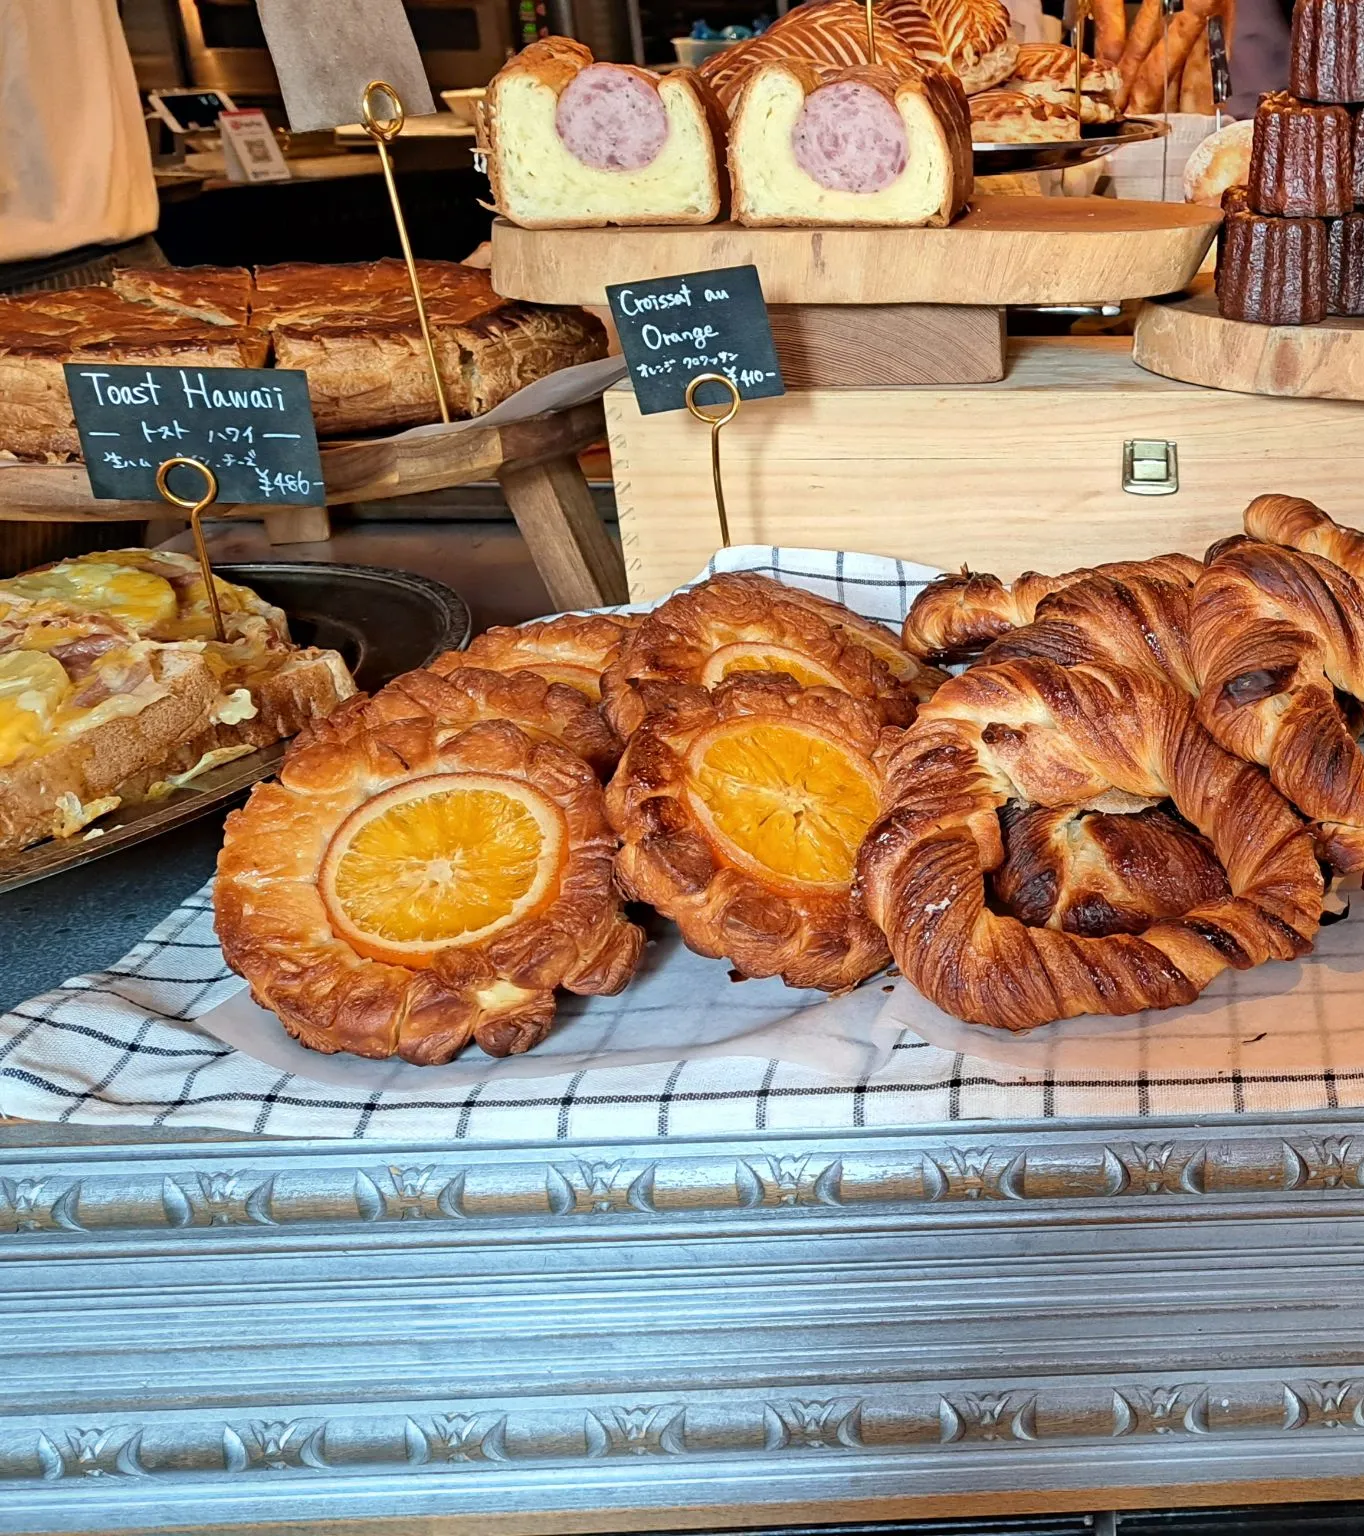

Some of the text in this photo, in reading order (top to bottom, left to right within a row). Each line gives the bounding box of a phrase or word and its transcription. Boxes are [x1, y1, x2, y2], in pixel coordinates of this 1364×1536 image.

[620, 284, 730, 316] Croissat au
[642, 324, 719, 350] Orange
[80, 369, 286, 412] Toast Hawaii
[207, 426, 254, 444] ハワイ
